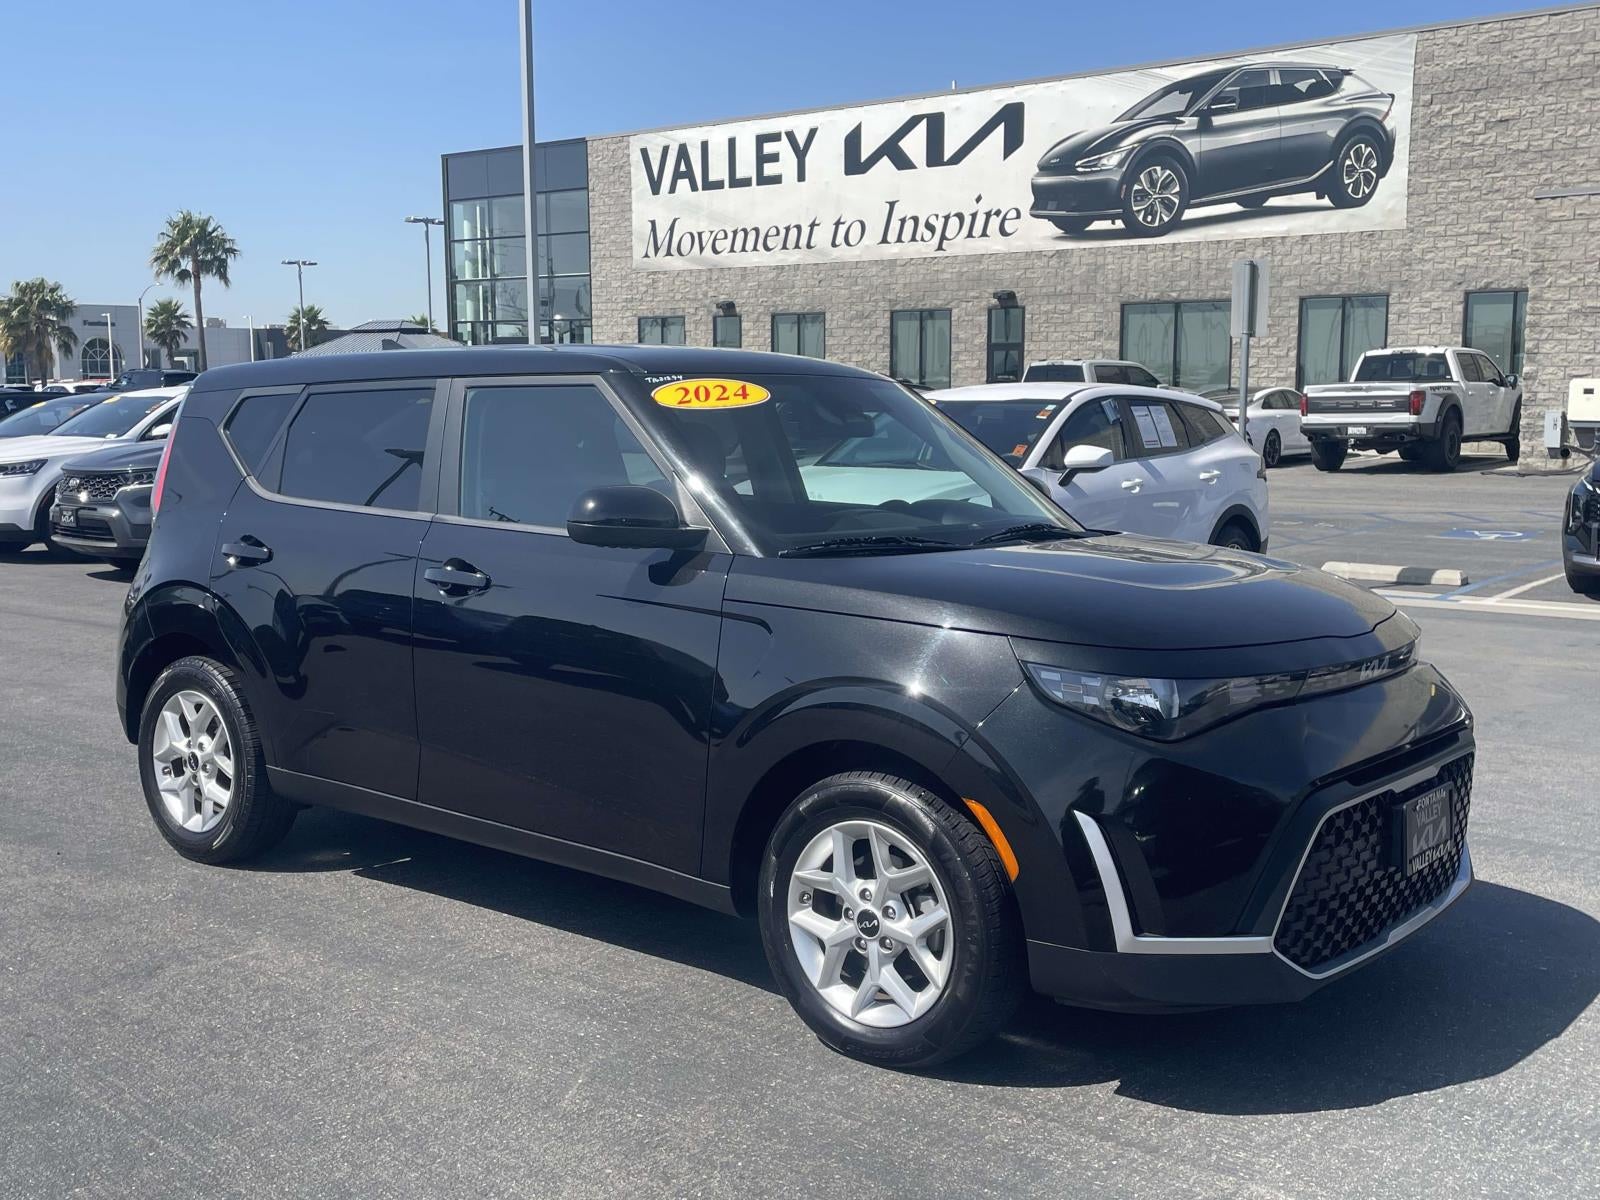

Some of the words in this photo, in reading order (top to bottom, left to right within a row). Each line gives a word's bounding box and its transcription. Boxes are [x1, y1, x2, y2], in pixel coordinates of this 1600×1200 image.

[640, 127, 818, 196] VALLEY
[844, 101, 1025, 176] KIA
[643, 217, 820, 258] Movement
[830, 214, 867, 247] to
[878, 193, 1023, 252] Inspire
[675, 384, 749, 405] 2024
[1416, 800, 1442, 828] VALLEY
[1412, 848, 1434, 873] VALLEY
[858, 919, 879, 929] KIA
